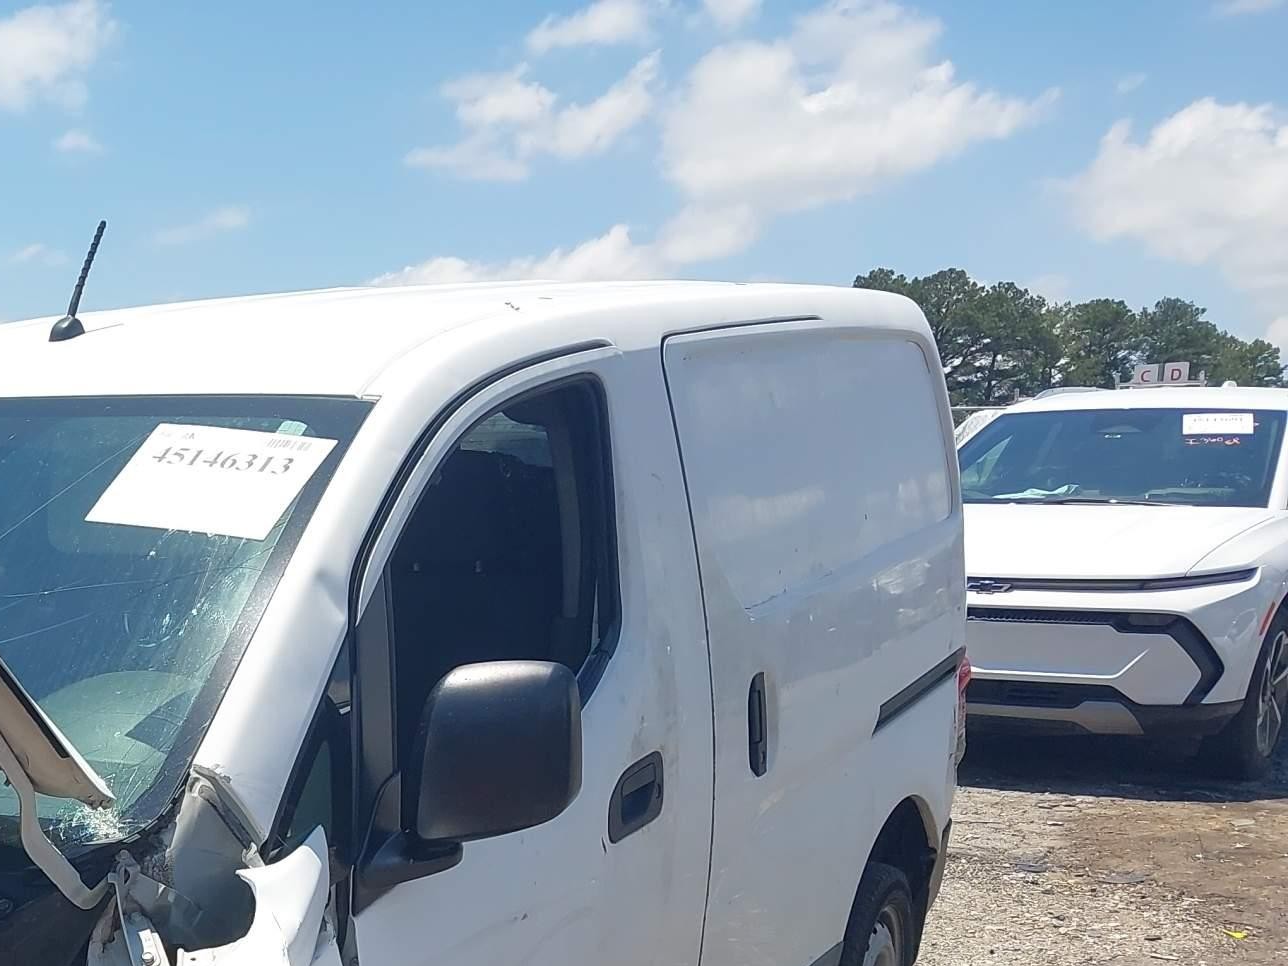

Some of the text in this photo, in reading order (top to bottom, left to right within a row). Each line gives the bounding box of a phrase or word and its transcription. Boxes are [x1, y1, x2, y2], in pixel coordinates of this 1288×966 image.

[1140, 369, 1152, 383] C
[1170, 368, 1182, 381] D
[151, 446, 295, 475] 45146313
